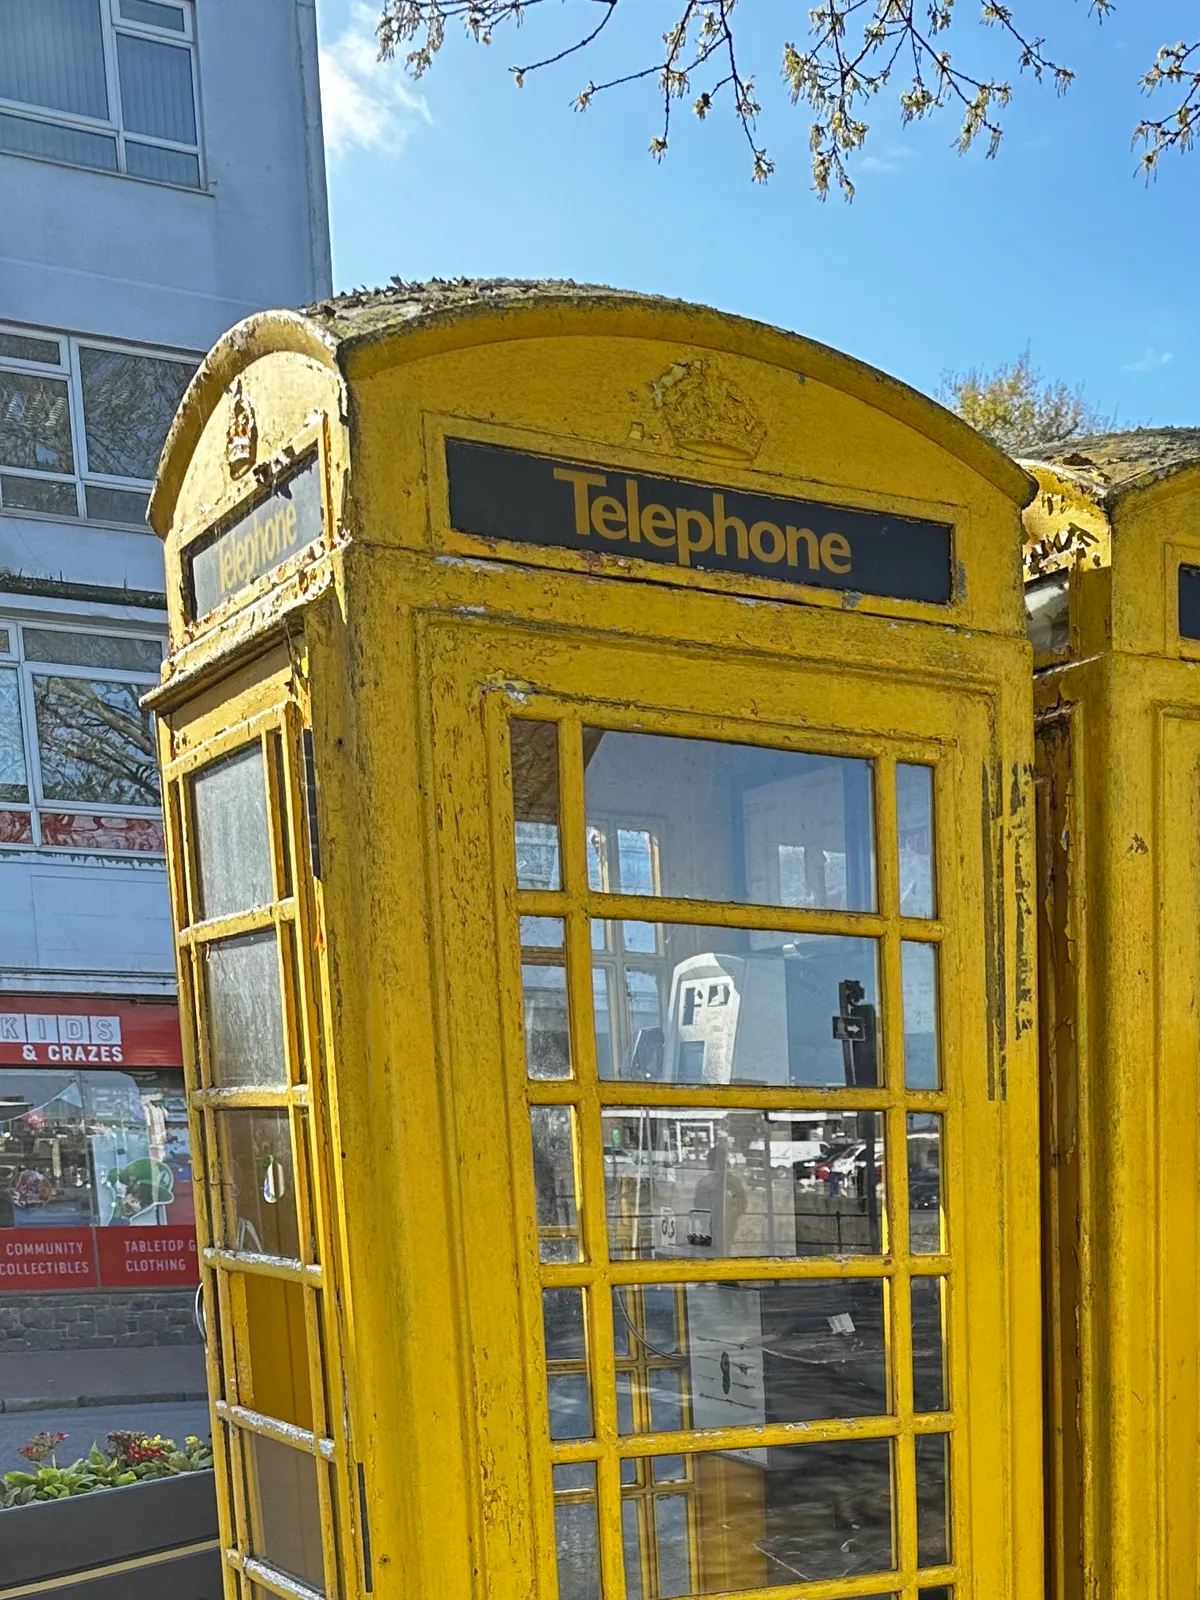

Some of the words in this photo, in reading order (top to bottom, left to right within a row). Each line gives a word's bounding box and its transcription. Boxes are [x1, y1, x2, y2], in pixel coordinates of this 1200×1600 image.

[553, 467, 852, 574] Telephone
[214, 503, 298, 593] Telephone
[0, 1017, 114, 1042] KIDS
[22, 1044, 38, 1060] &
[48, 1045, 123, 1062] CRAZES
[6, 1241, 83, 1256] COMMUNITY
[124, 1239, 184, 1253] TABLETOP
[0, 1261, 89, 1276] COLLECTIBLES
[126, 1258, 186, 1272] CLOTHING
